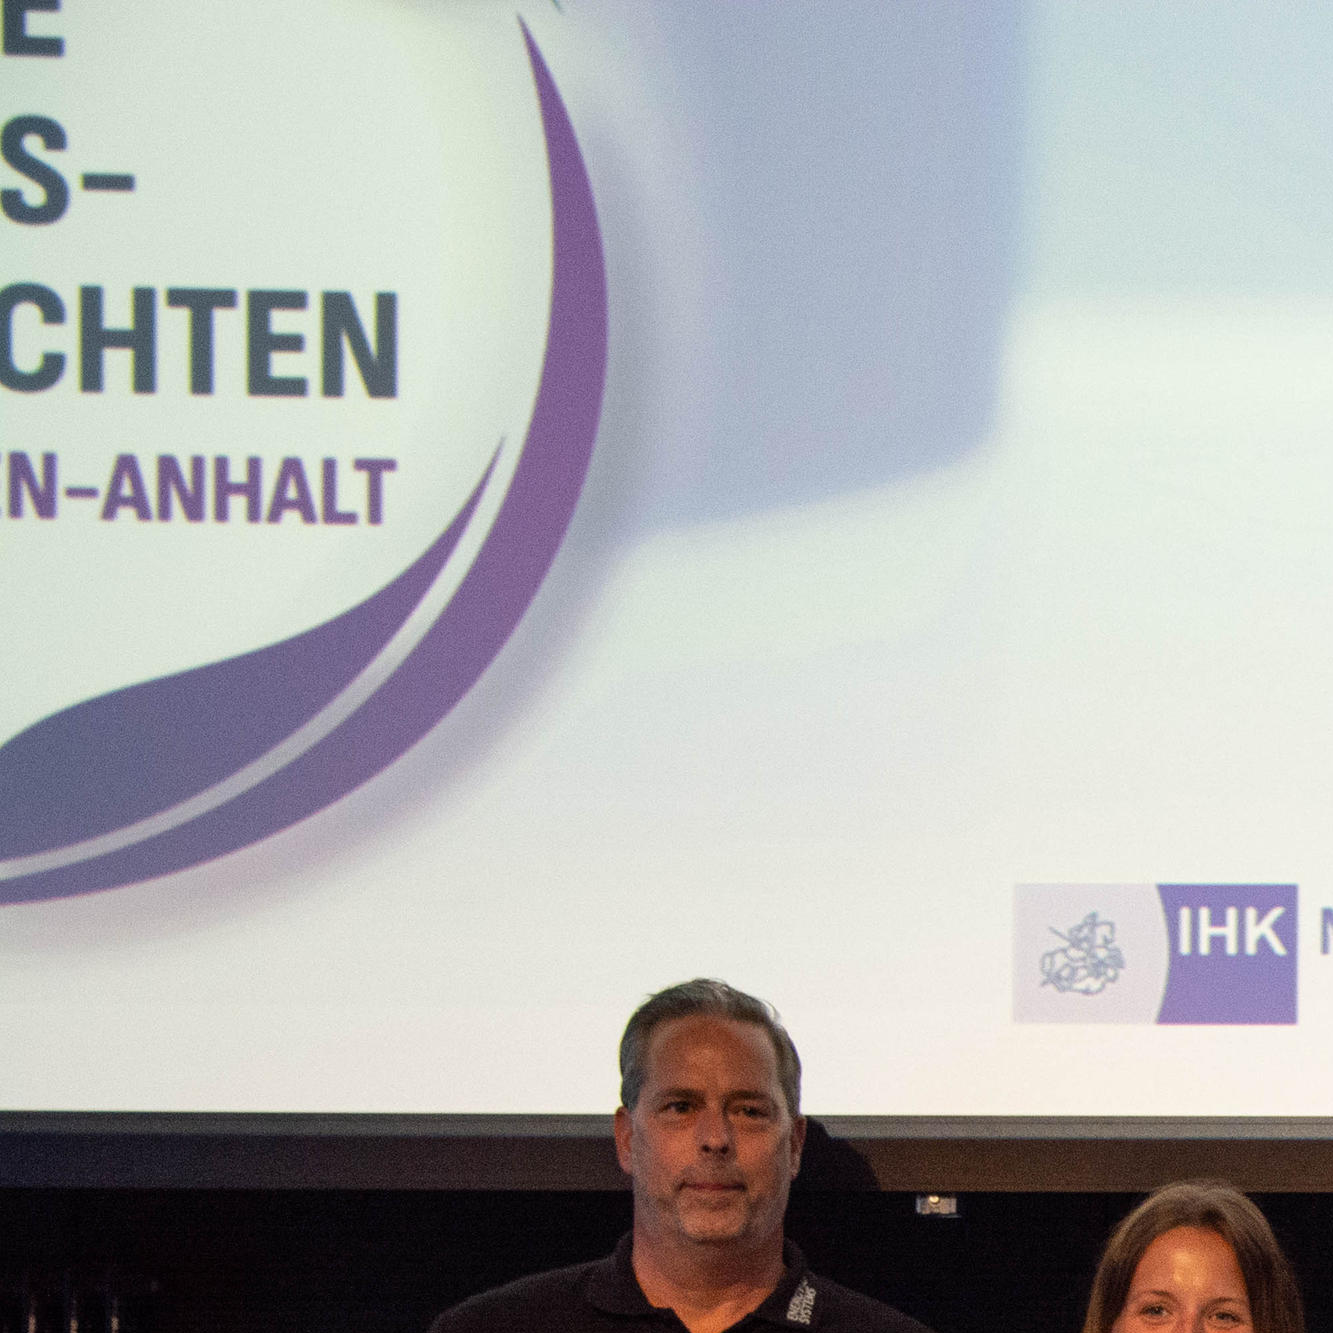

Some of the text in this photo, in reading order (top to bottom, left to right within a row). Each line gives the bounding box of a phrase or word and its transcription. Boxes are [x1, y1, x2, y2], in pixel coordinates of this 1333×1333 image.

[0, 281, 398, 399] CHTEN
[0, 450, 397, 525] N-ANHALT
[1177, 905, 1288, 956] IHK
